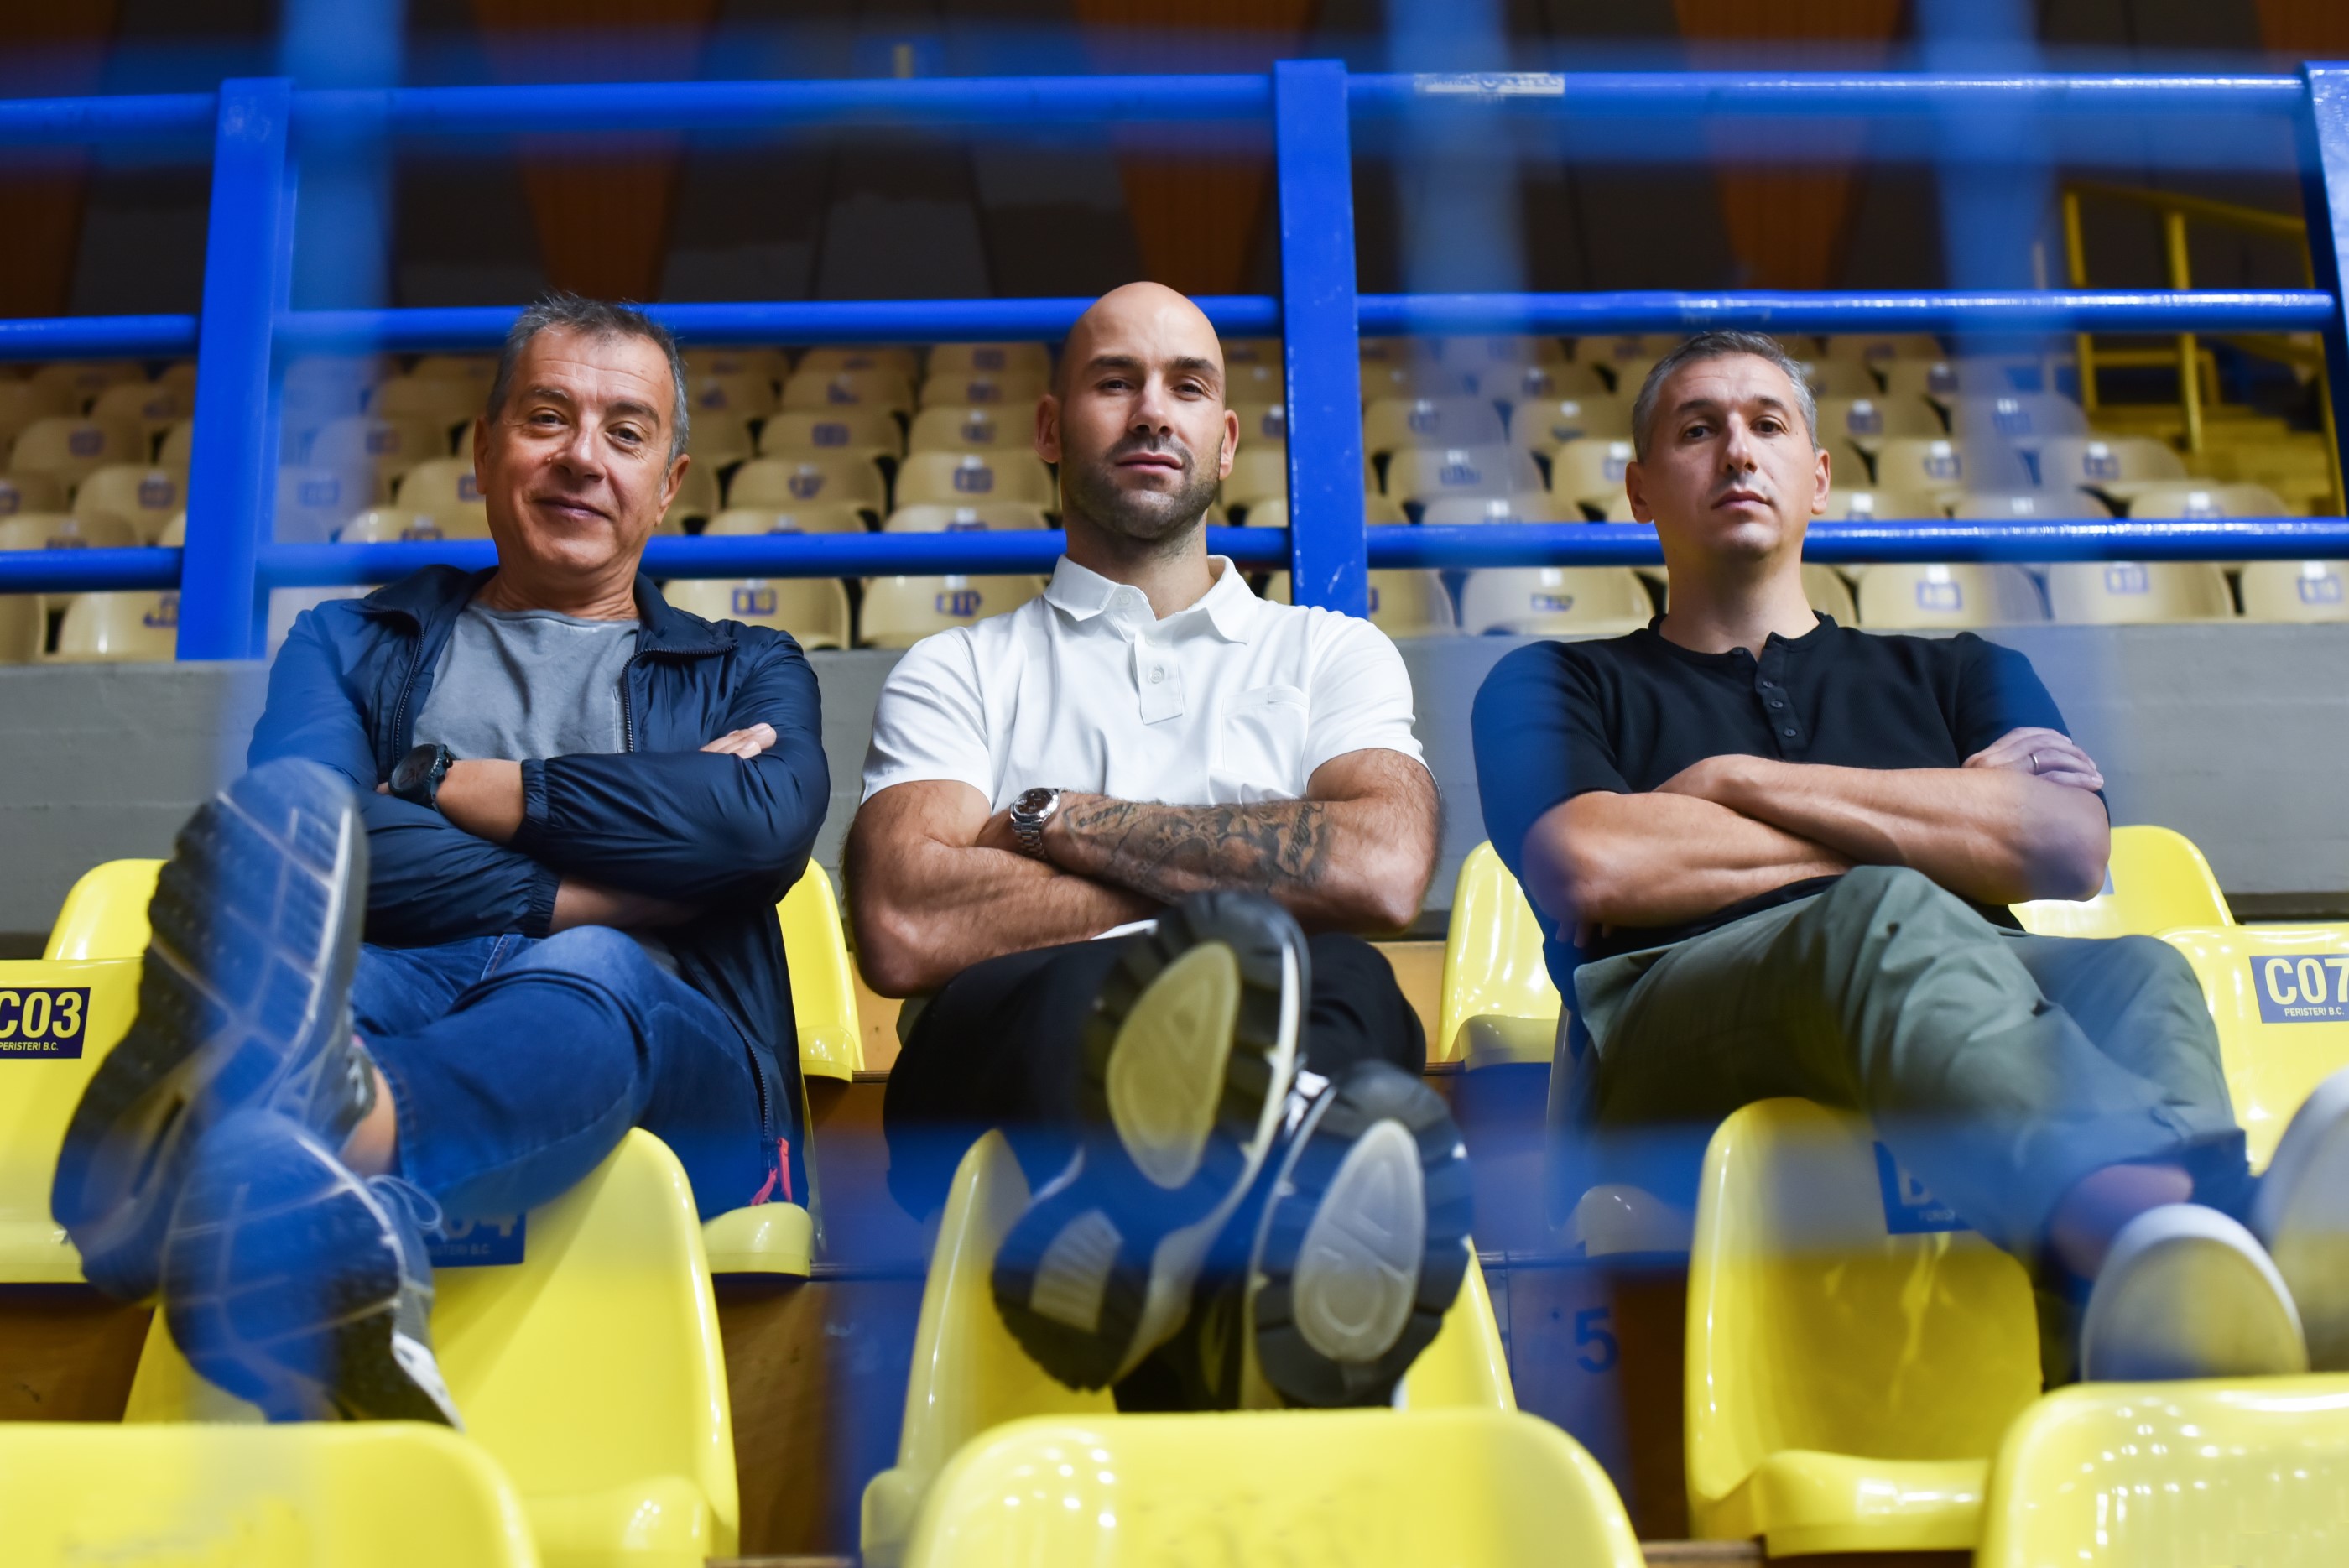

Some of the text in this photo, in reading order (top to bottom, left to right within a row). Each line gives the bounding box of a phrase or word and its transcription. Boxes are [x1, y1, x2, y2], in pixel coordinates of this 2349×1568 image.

[2264, 957, 2349, 1005] C07
[0, 991, 82, 1039] C03
[2284, 1006, 2345, 1017] PERISTERI B.C.
[43, 1041, 59, 1050] B.C.
[1575, 1306, 1620, 1374] 5
